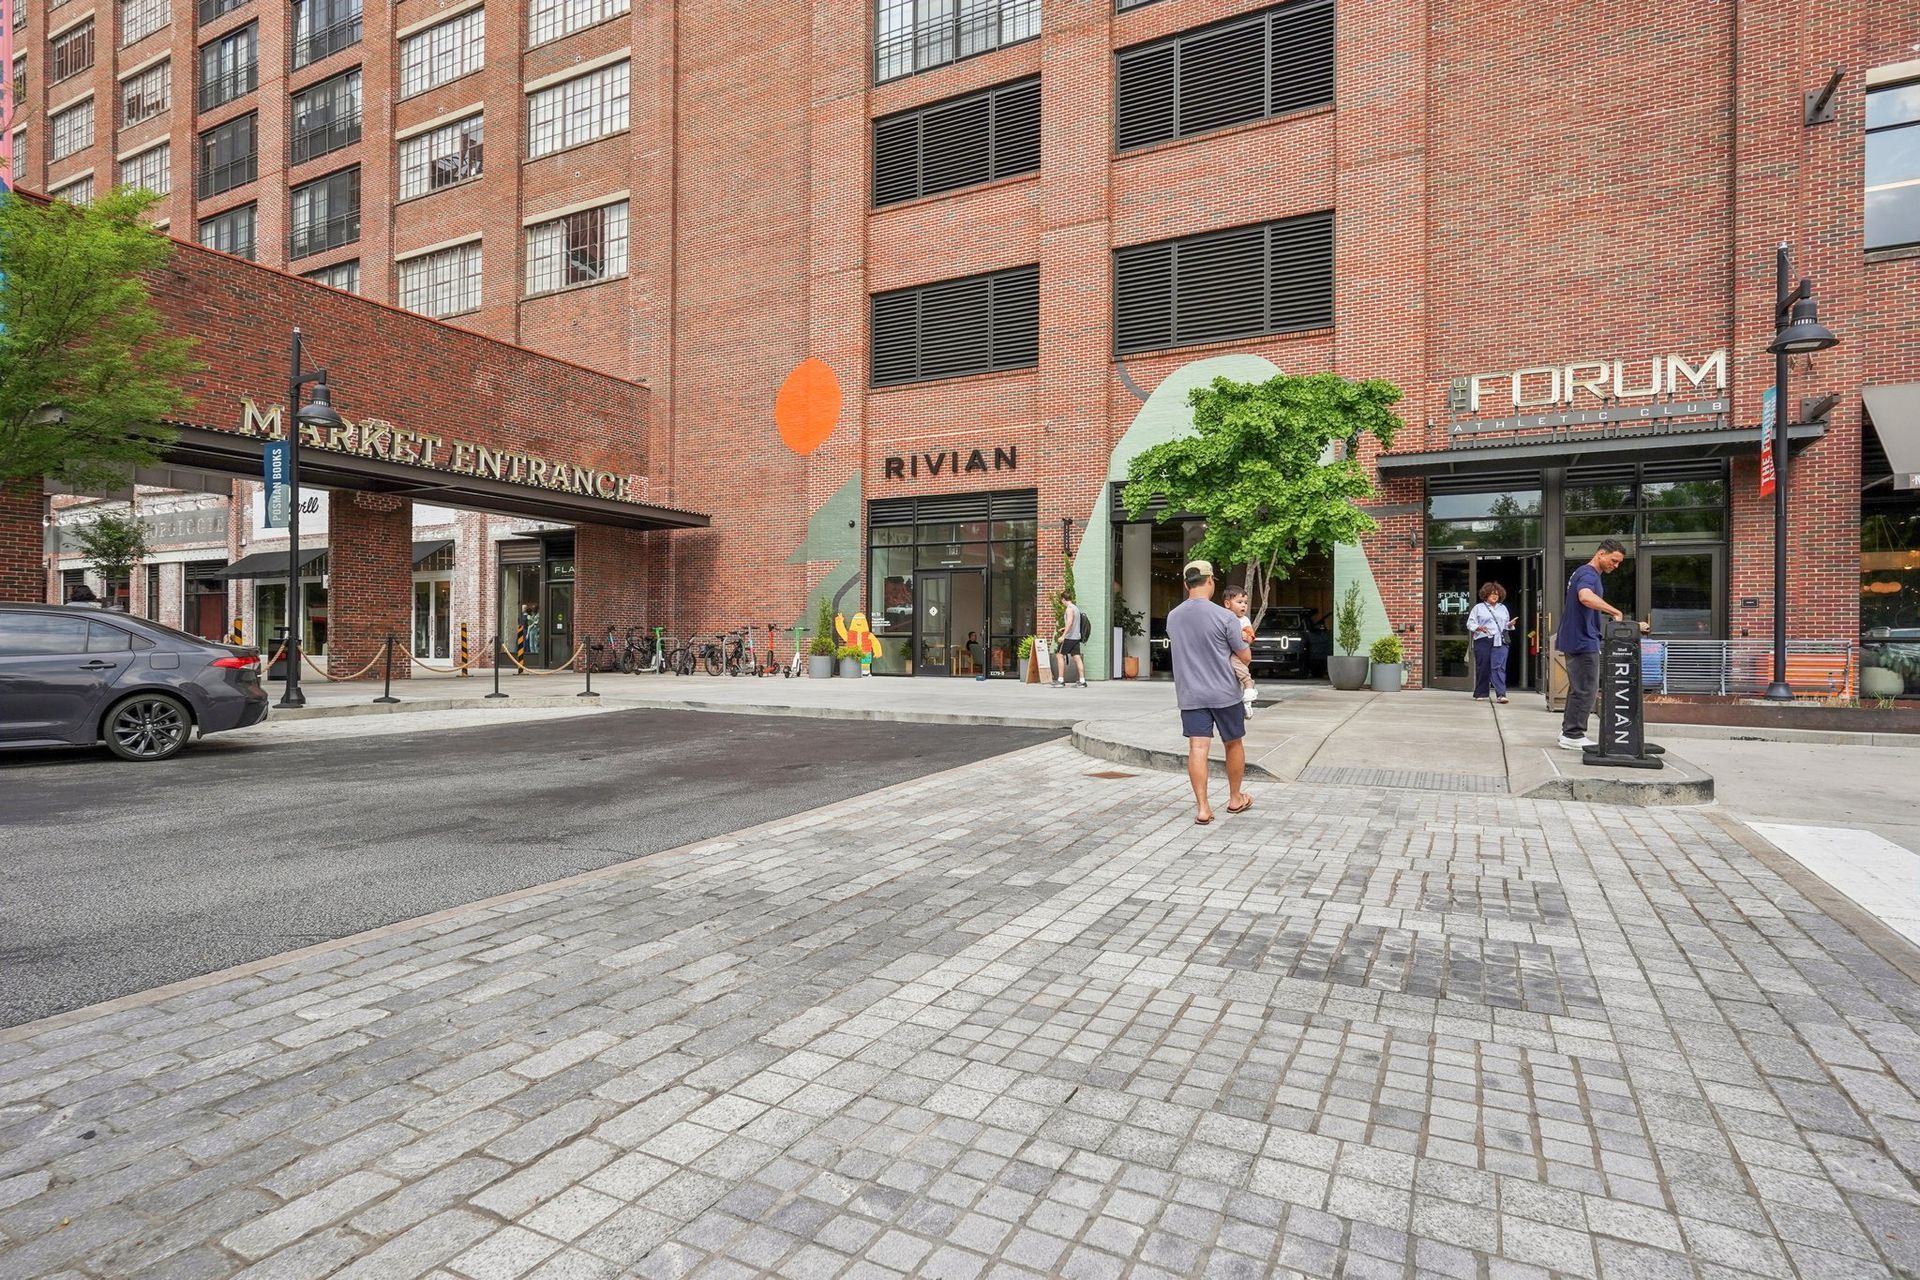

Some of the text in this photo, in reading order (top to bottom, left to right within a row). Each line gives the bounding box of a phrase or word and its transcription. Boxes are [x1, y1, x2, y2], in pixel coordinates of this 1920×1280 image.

[1453, 376, 1468, 410] THE
[1470, 348, 1726, 412] FORUM
[1453, 402, 1722, 432] ATHLETIC CLUB
[272, 448, 282, 521] POSMAN BOOKS
[450, 439, 632, 501] ENTRANCE
[885, 445, 1017, 479] RIVIAN
[1614, 663, 1630, 744] RIVIAN
